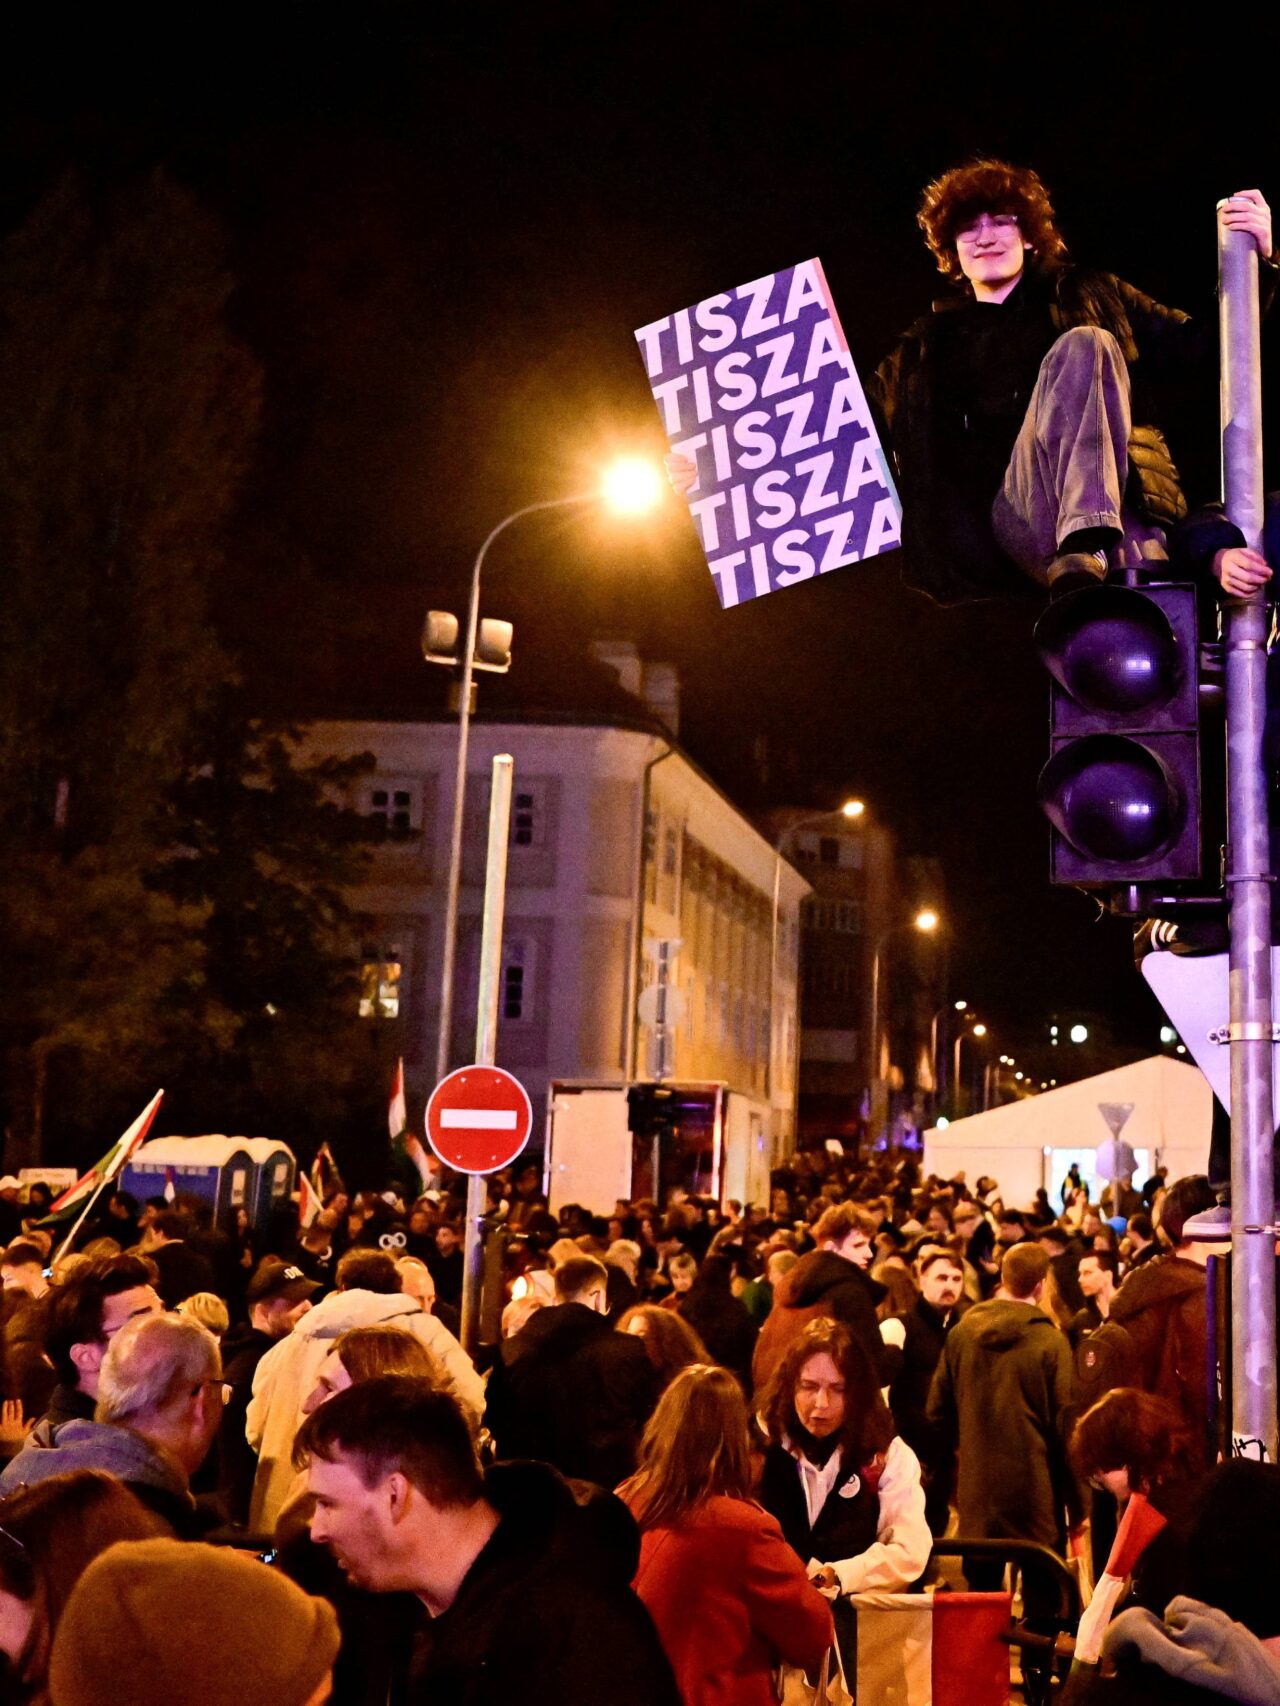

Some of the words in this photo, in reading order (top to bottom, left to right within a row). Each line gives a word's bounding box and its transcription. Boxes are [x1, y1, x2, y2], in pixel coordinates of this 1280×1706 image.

[636, 258, 828, 378] TISZA
[652, 318, 848, 436] TISZA
[669, 377, 869, 494] TISZA
[689, 436, 887, 553] TISZA
[708, 498, 902, 609] TISZA
